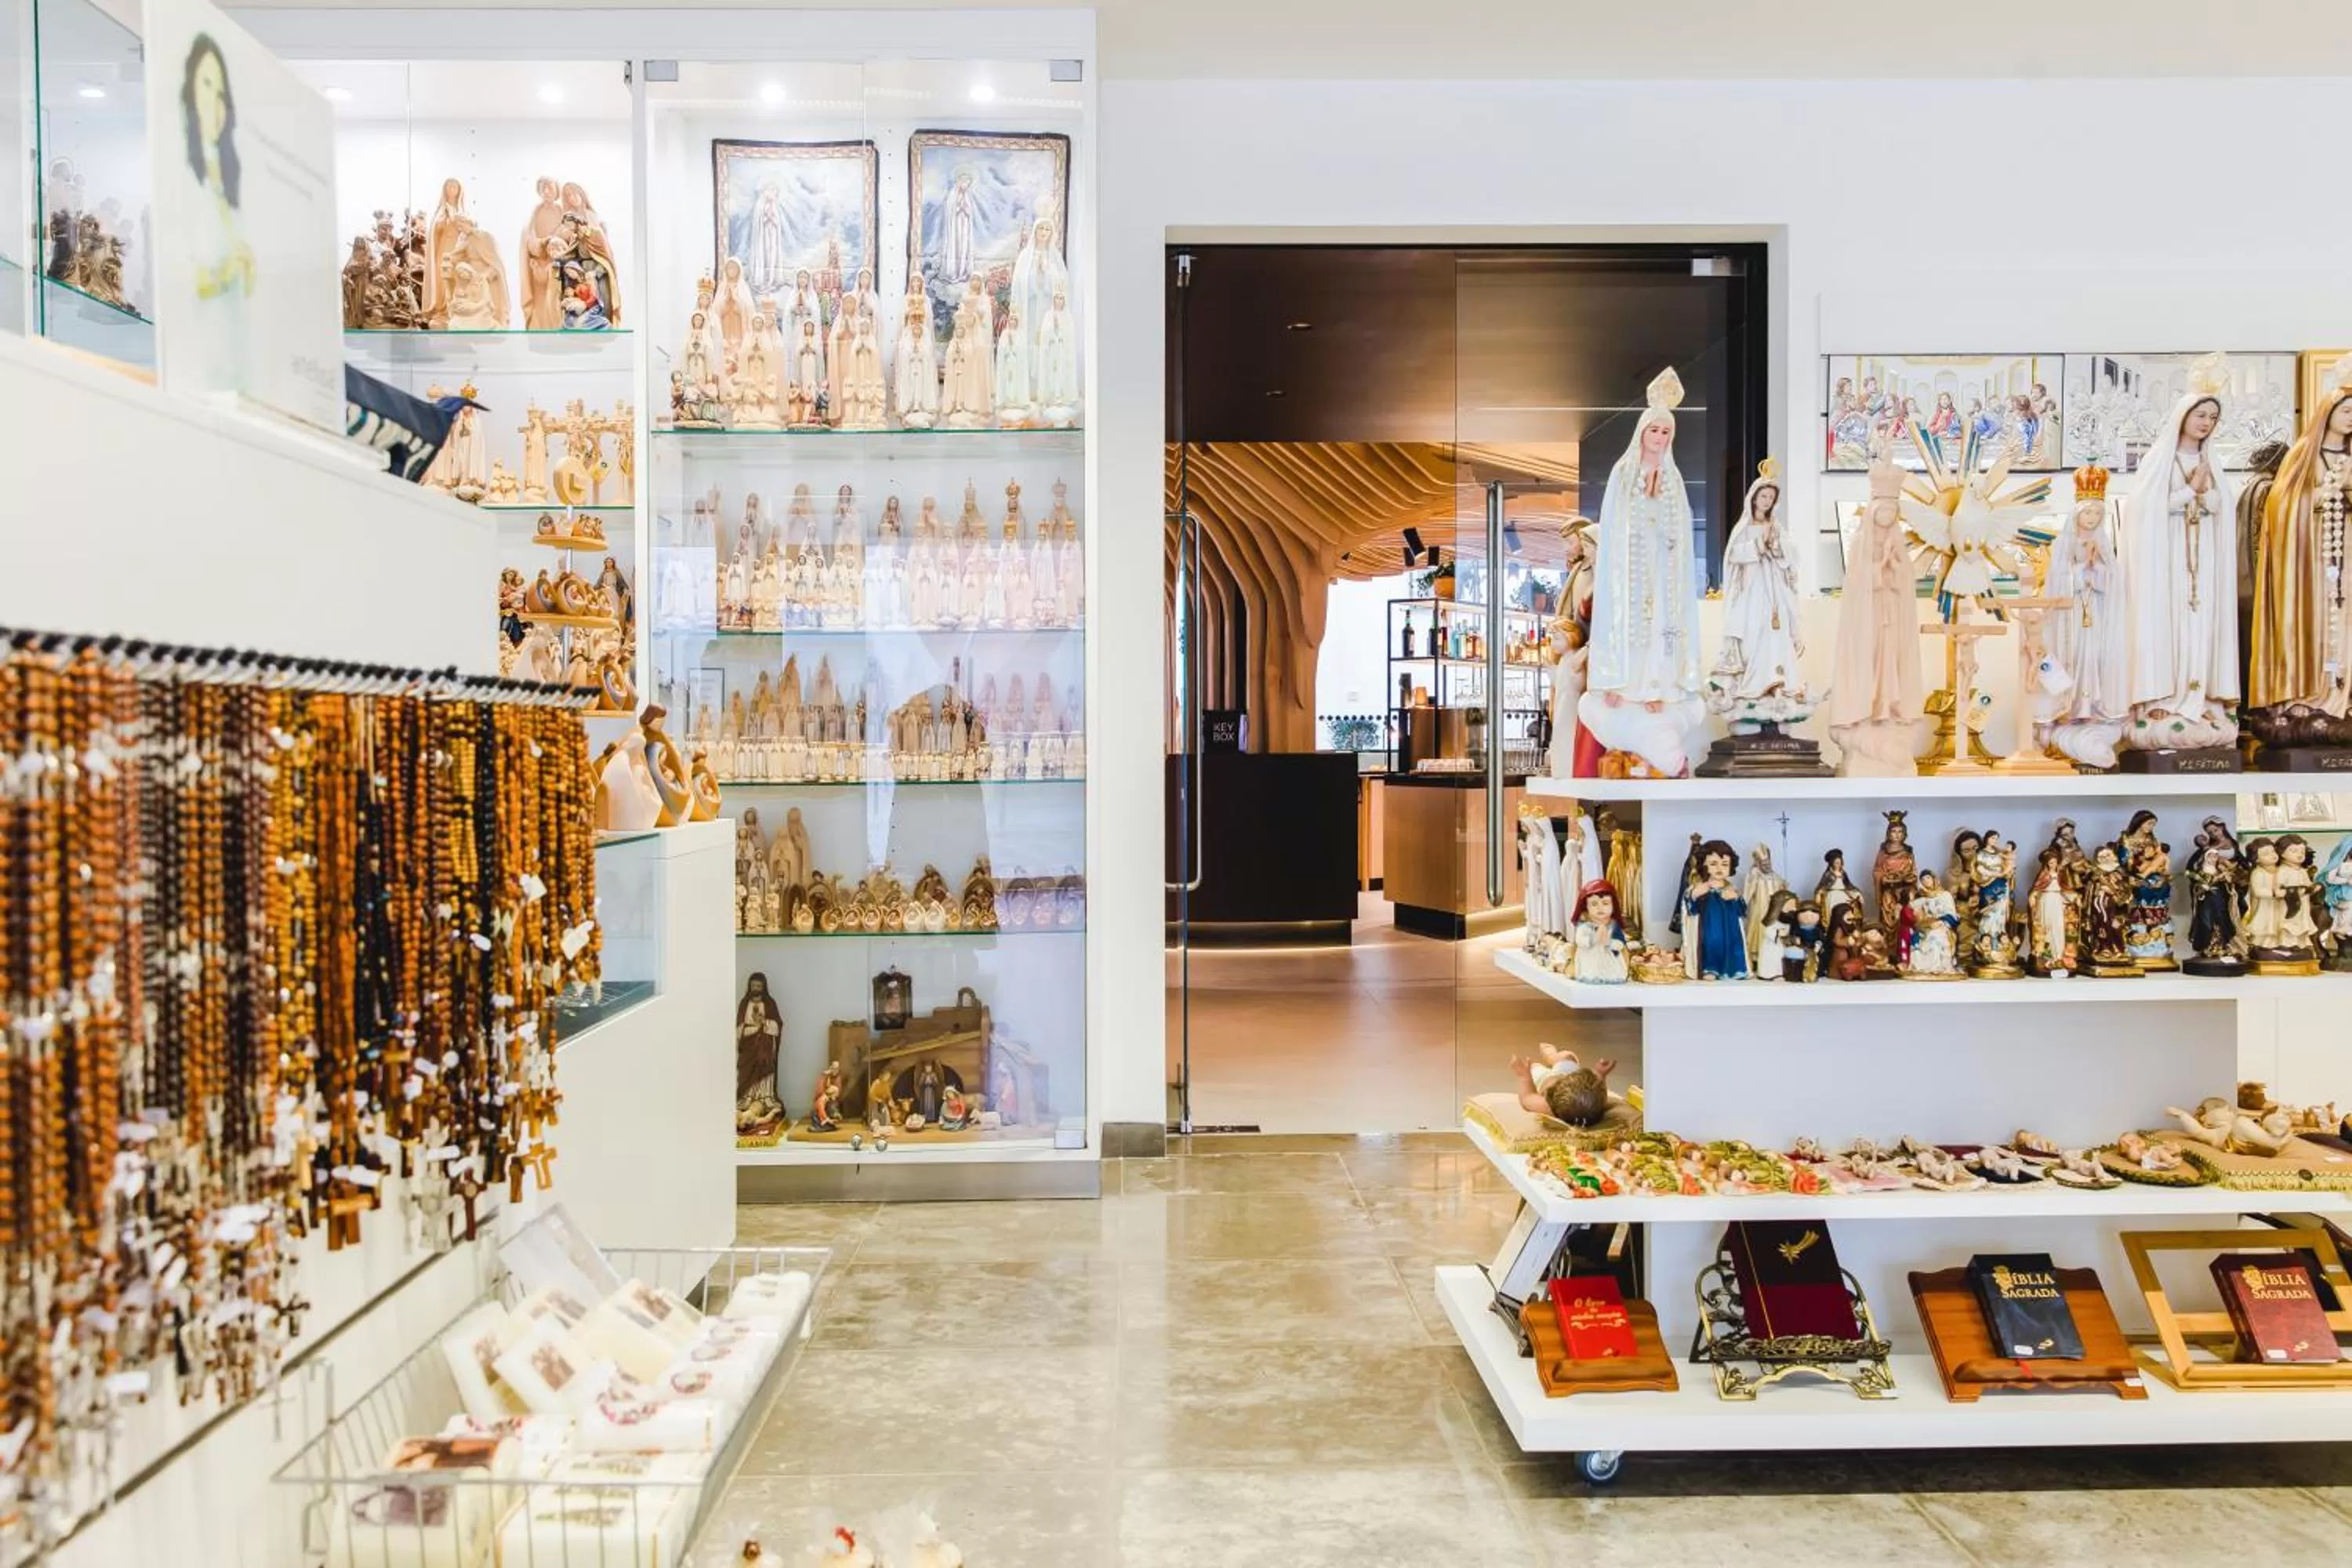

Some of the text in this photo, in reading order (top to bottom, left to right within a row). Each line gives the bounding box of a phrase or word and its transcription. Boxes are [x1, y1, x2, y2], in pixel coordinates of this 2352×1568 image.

[1213, 721, 1235, 731] KEY
[1213, 731, 1235, 741] BOX
[2001, 1288, 2061, 1299] SAGRADA
[2252, 1288, 2313, 1299] SAGRADA
